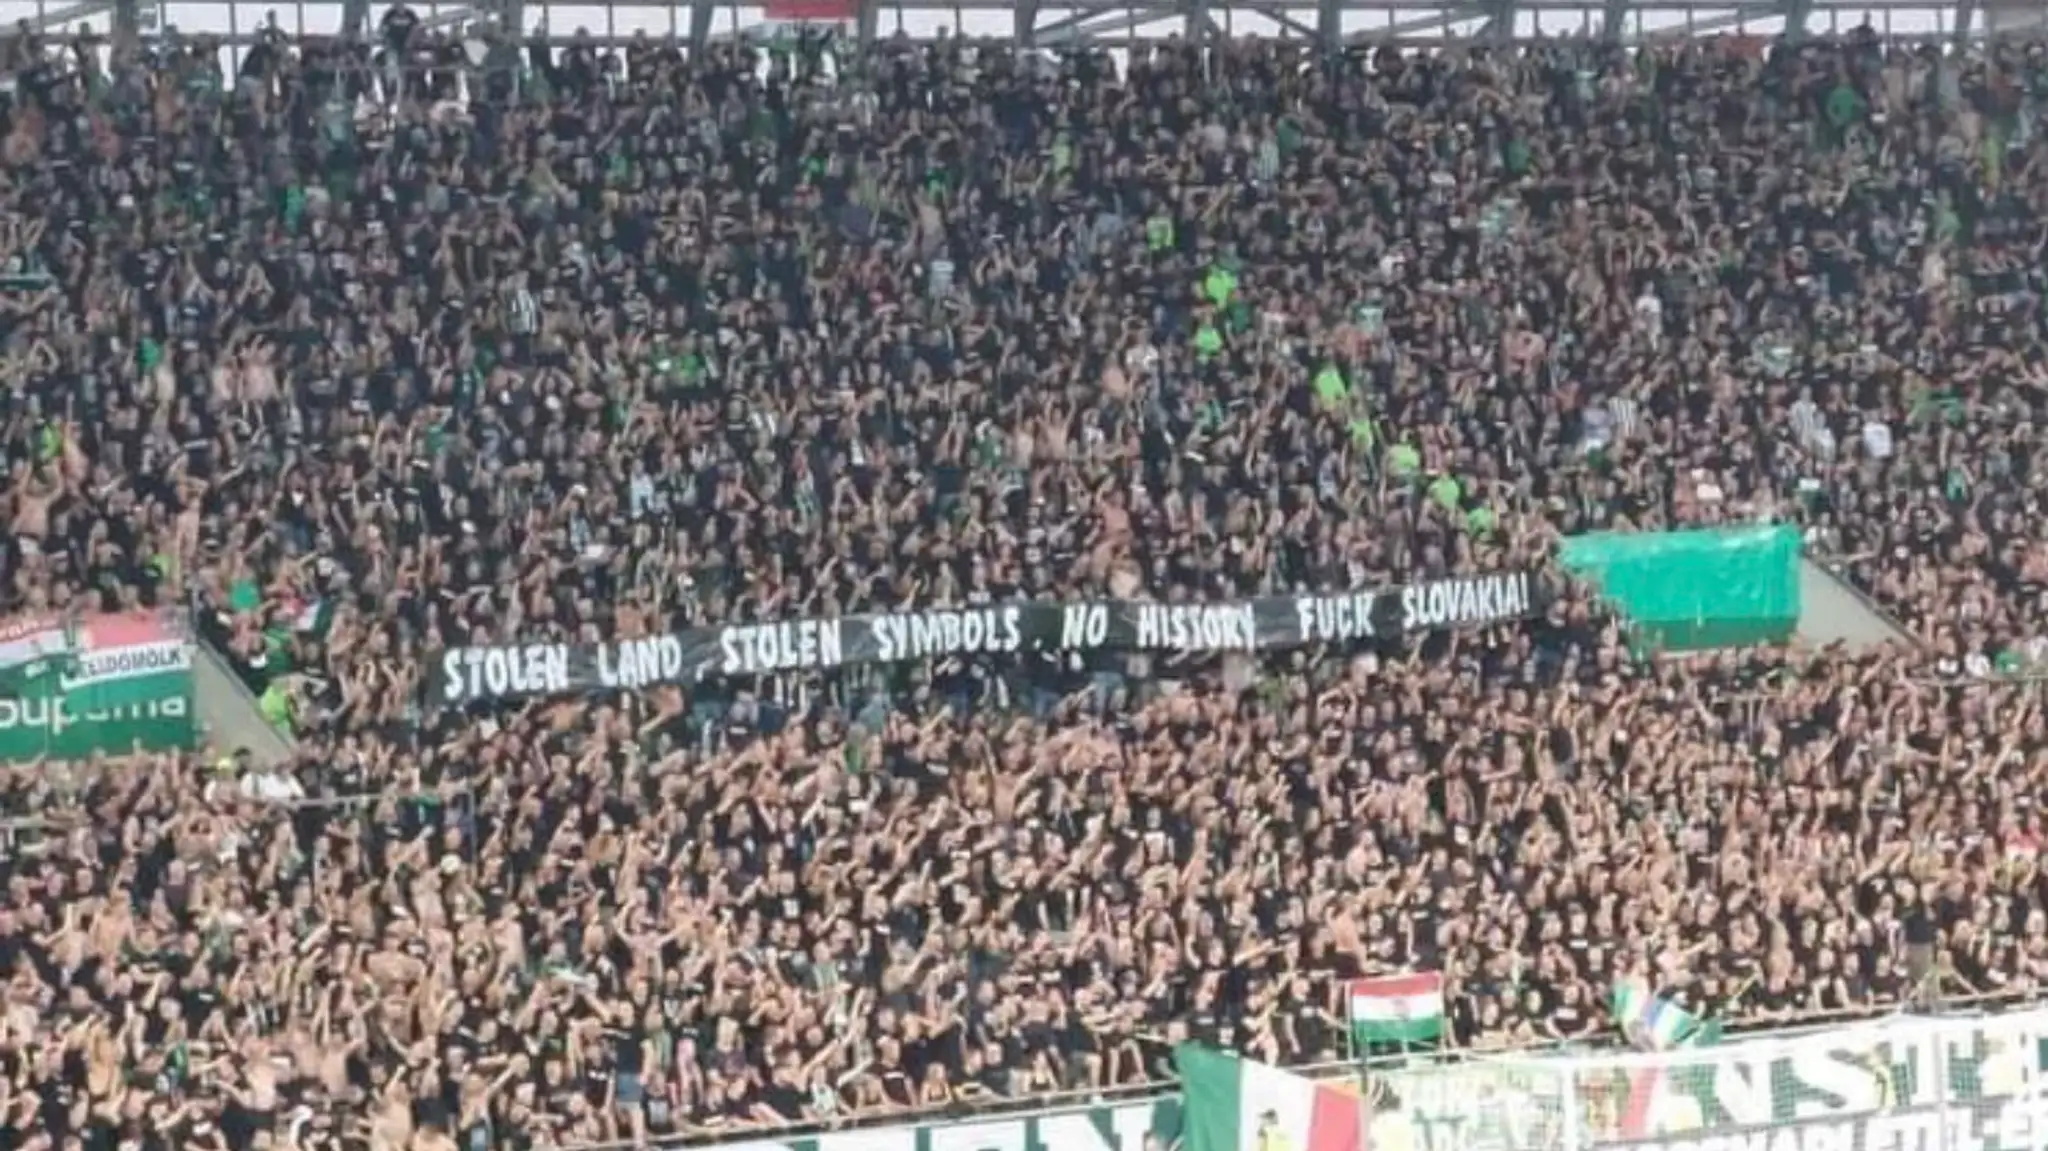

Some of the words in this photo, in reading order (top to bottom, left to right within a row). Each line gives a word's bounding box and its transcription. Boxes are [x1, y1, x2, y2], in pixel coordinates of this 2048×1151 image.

[443, 642, 568, 699] STOLEN
[720, 618, 841, 673] STOLEN
[1062, 603, 1109, 648] NO
[1137, 603, 1256, 654] HISTORY
[1297, 592, 1376, 641] FUCK
[1403, 573, 1529, 629] SLOVAKIA!
